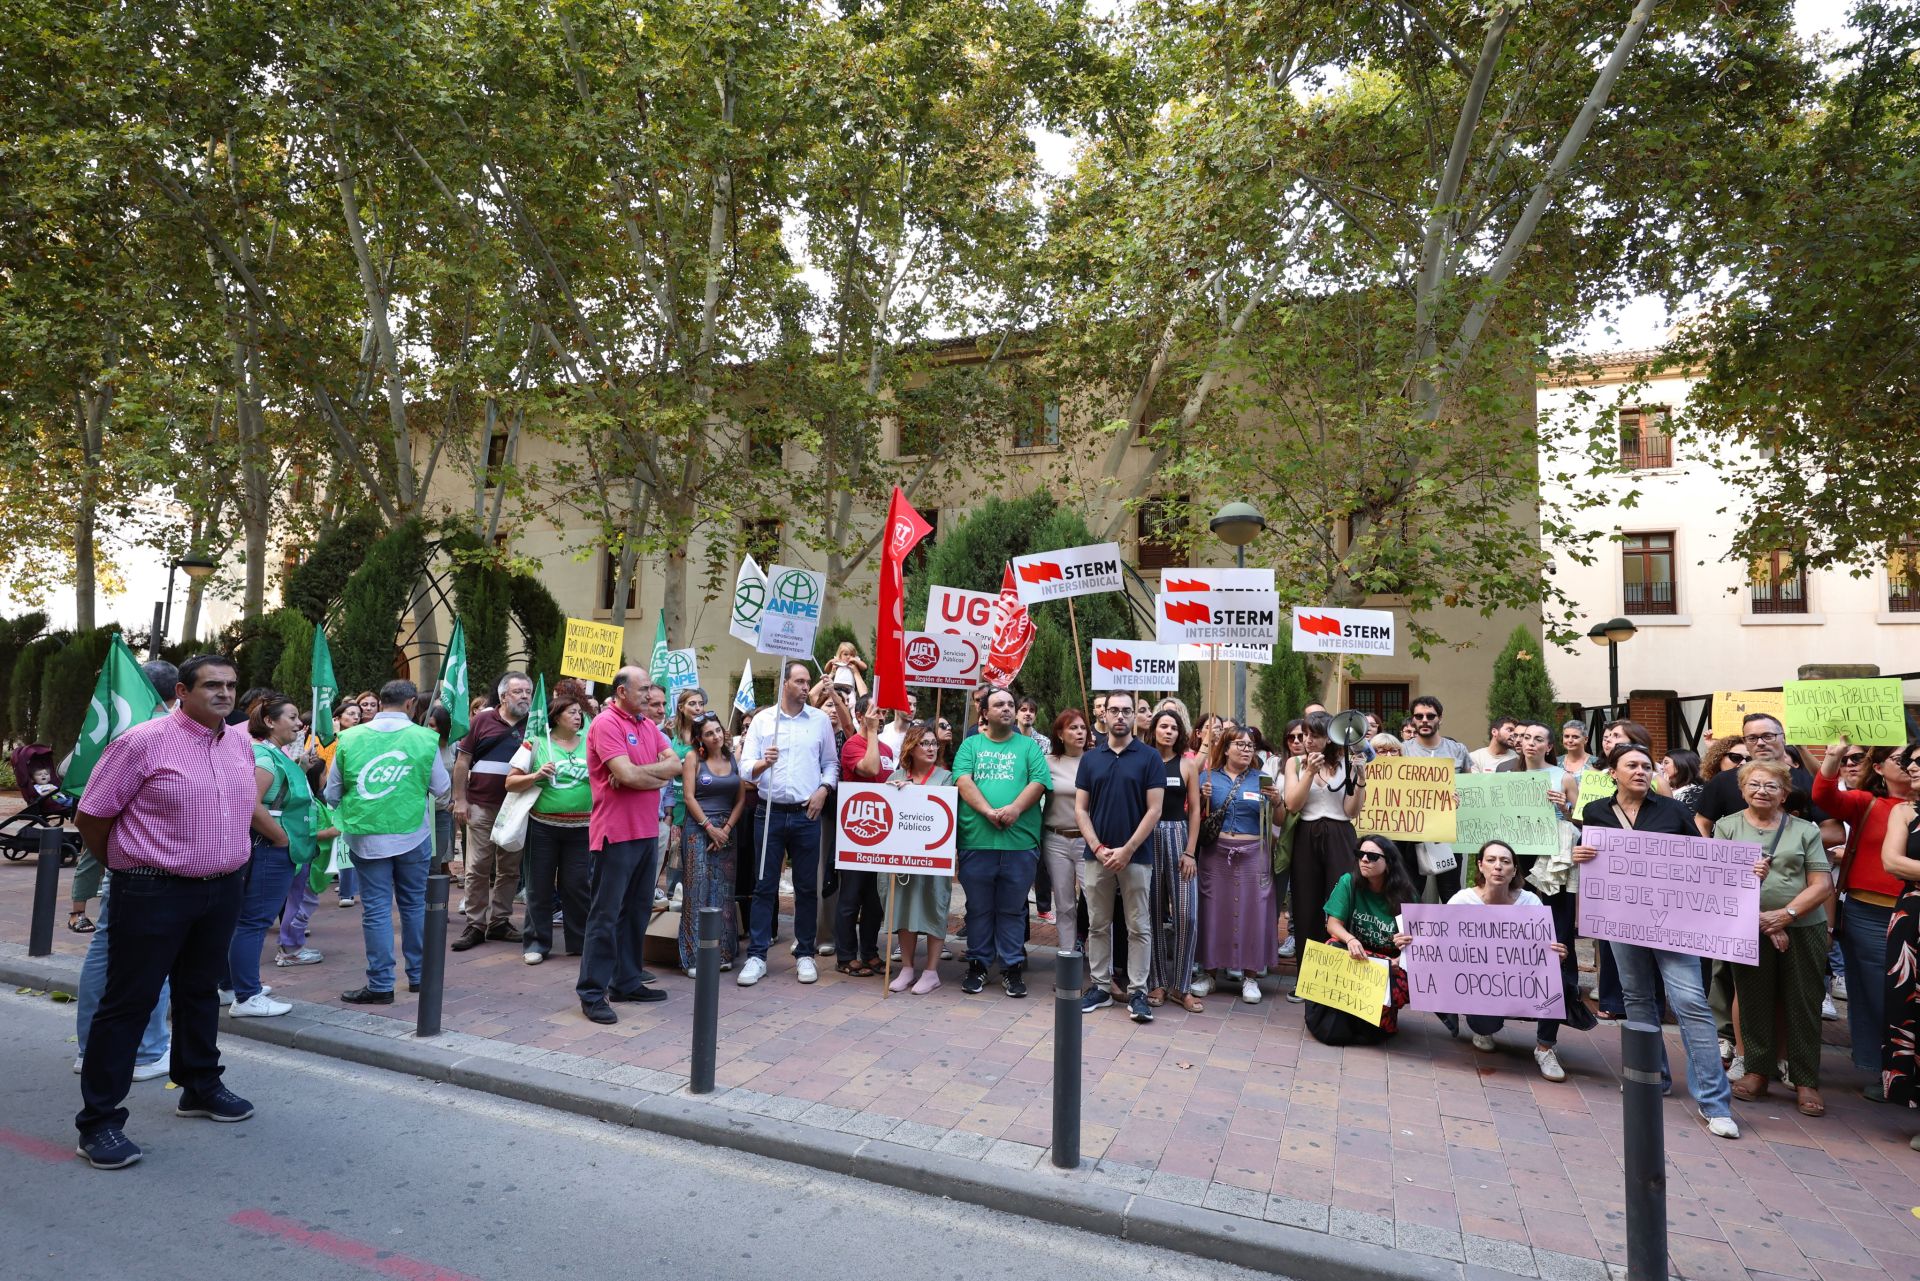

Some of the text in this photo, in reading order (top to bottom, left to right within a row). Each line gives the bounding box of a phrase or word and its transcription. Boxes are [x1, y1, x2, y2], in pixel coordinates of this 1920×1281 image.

[1064, 560, 1117, 580] STERM
[1041, 576, 1119, 596] INTERSINDICAL
[766, 597, 819, 619] ANPE
[941, 593, 999, 627] UG
[1213, 610, 1273, 625] STERM
[568, 623, 594, 639] DOCENTES
[600, 628, 620, 644] FRENTE
[1186, 627, 1273, 638] INTERSINDICAL
[1343, 625, 1390, 639] STERM
[910, 642, 936, 657] UGT
[1318, 638, 1390, 650] INTERSINDICAL
[565, 655, 616, 678] TRANSPARENTE
[942, 656, 965, 664] Públicos
[1135, 659, 1176, 673] STERM
[668, 672, 697, 687] NPE
[915, 674, 935, 684] Región
[945, 677, 966, 685] Murcia
[1113, 674, 1176, 686] INTERSINDICAL
[1806, 705, 1902, 722] OPOSICIONES
[1856, 723, 1888, 741] NO
[368, 765, 413, 783] CSIF
[1371, 787, 1379, 806] A
[1385, 787, 1400, 807] UN
[1406, 788, 1452, 811] SISTEMA
[846, 800, 887, 823] UGT
[899, 811, 934, 822] Servicios
[898, 821, 931, 832] Públicos
[1586, 829, 1761, 866] OPOSICIONES
[856, 853, 934, 867] Región de Murcia
[1436, 858, 1454, 869] ROSE
[1608, 856, 1757, 889] DOCENTES
[1585, 878, 1739, 917] OBJETIVAS
[1651, 910, 1668, 927] Y
[1409, 921, 1448, 937] MEJOR
[1459, 918, 1552, 941] REMUNERACIÓN
[1586, 915, 1757, 959] TRANSPARENTES
[1412, 943, 1547, 966] PARA QUIEN EVALÚA
[1315, 969, 1372, 998] MI FUTURO
[1415, 971, 1549, 999] LA OPOSICIÓN
[1302, 981, 1374, 1016] HE PERDIDO
